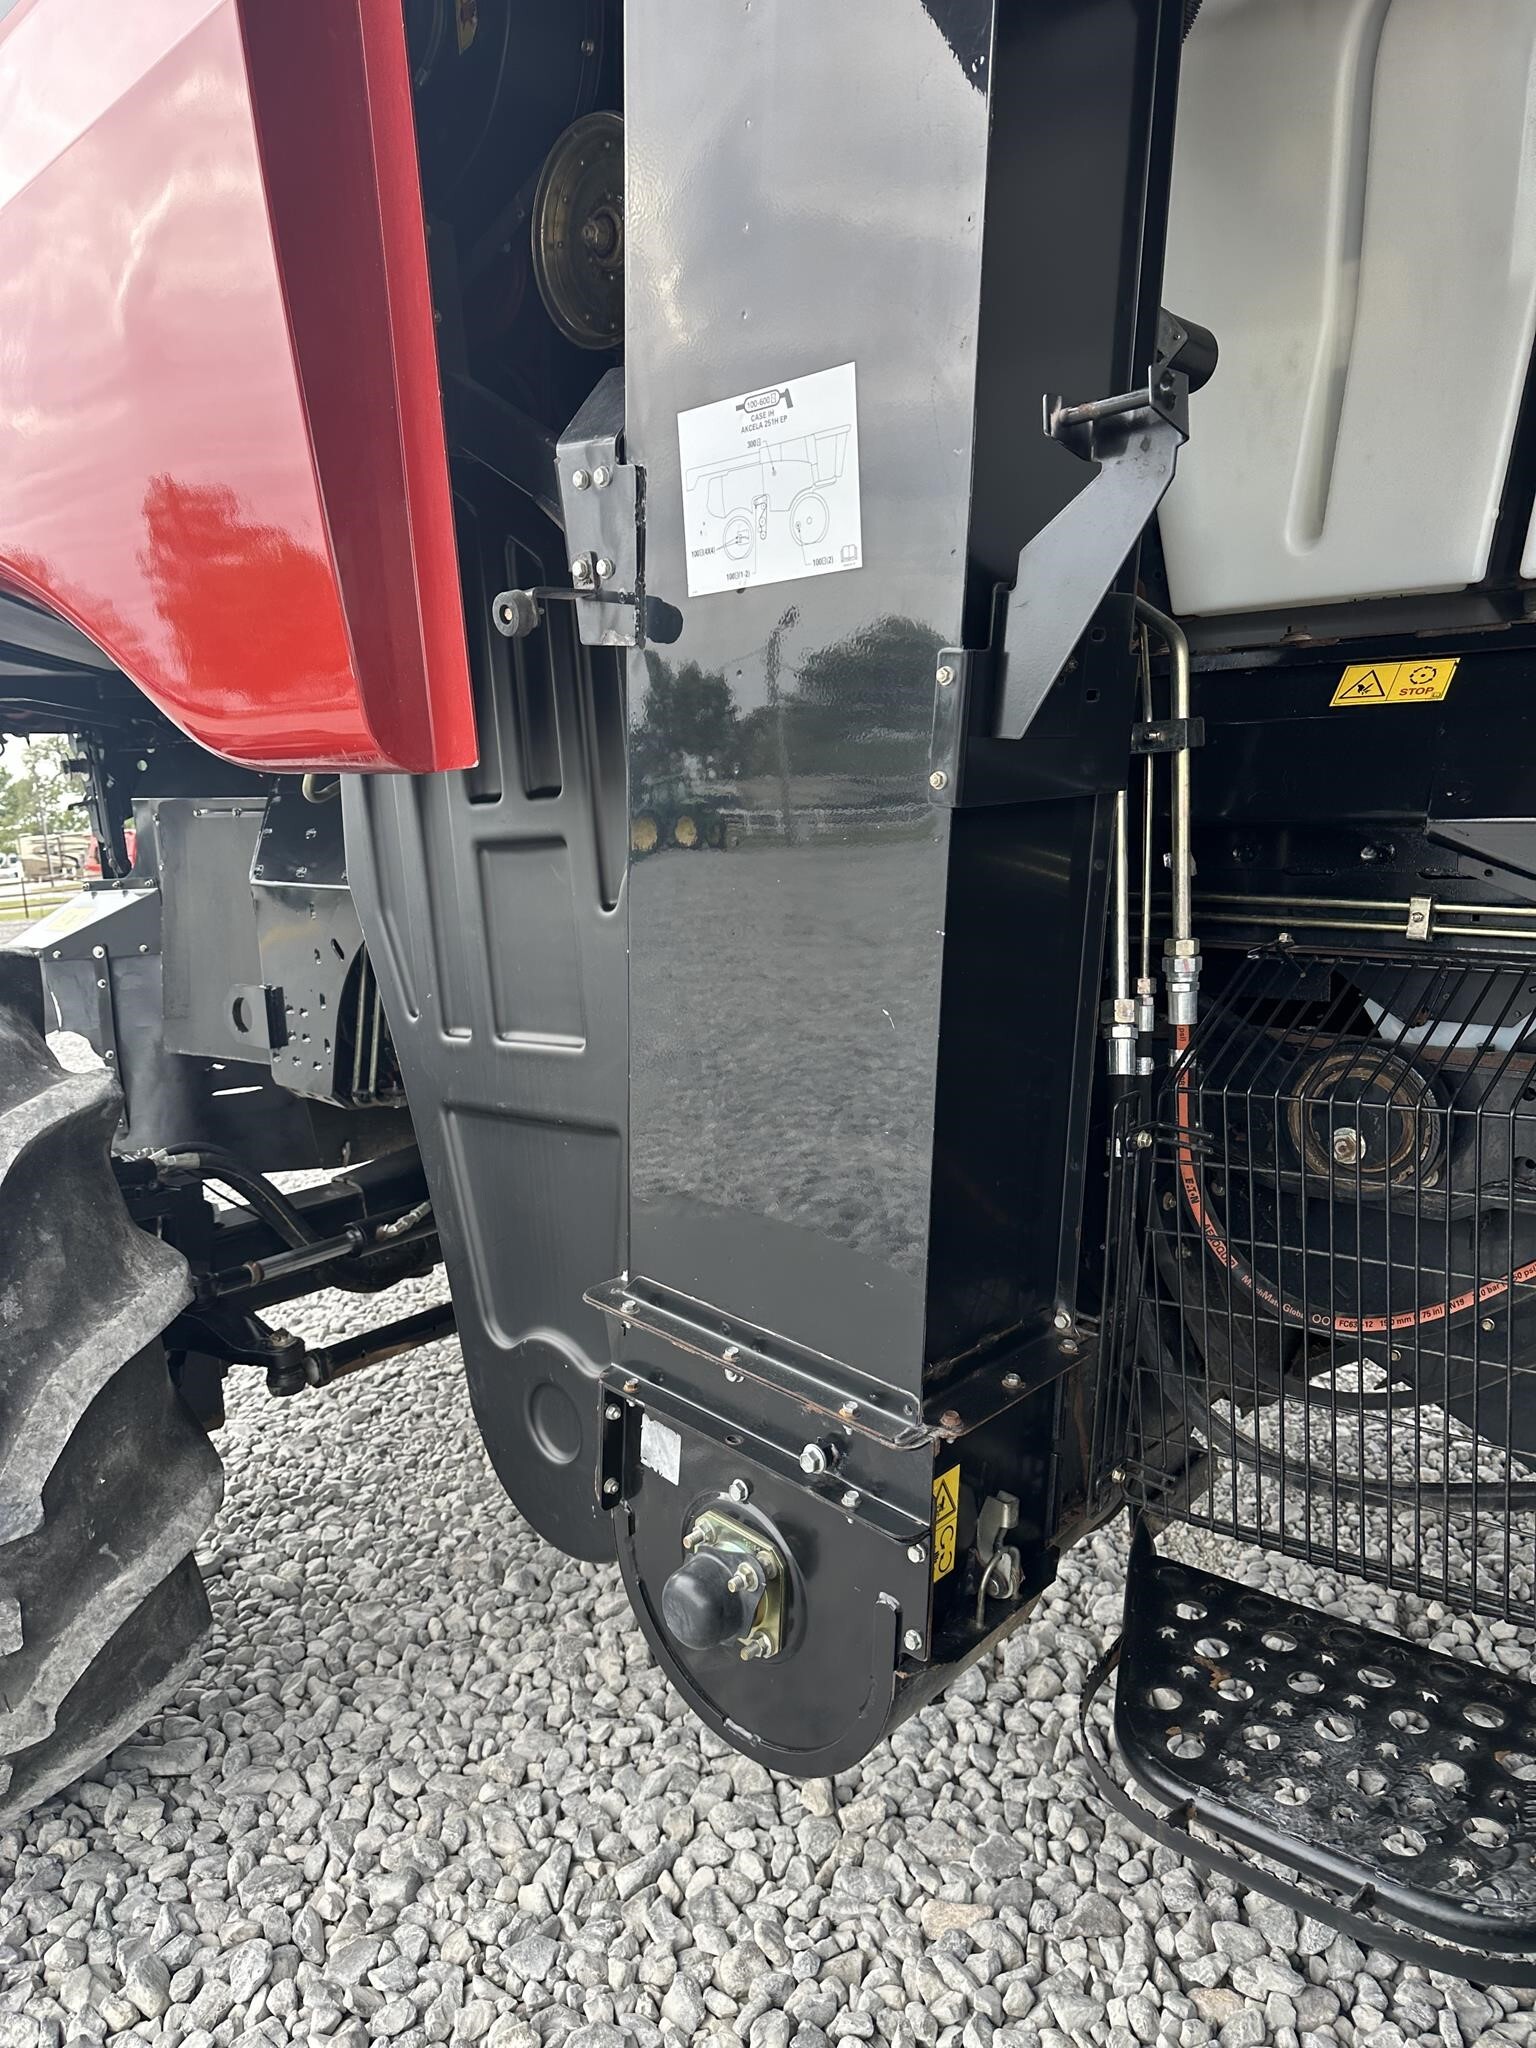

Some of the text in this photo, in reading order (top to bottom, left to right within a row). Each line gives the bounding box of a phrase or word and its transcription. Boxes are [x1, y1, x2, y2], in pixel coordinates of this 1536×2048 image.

[750, 409, 775, 422] CASE IH
[740, 414, 788, 434] AKCELA 251H EP
[1399, 686, 1435, 696] STOP
